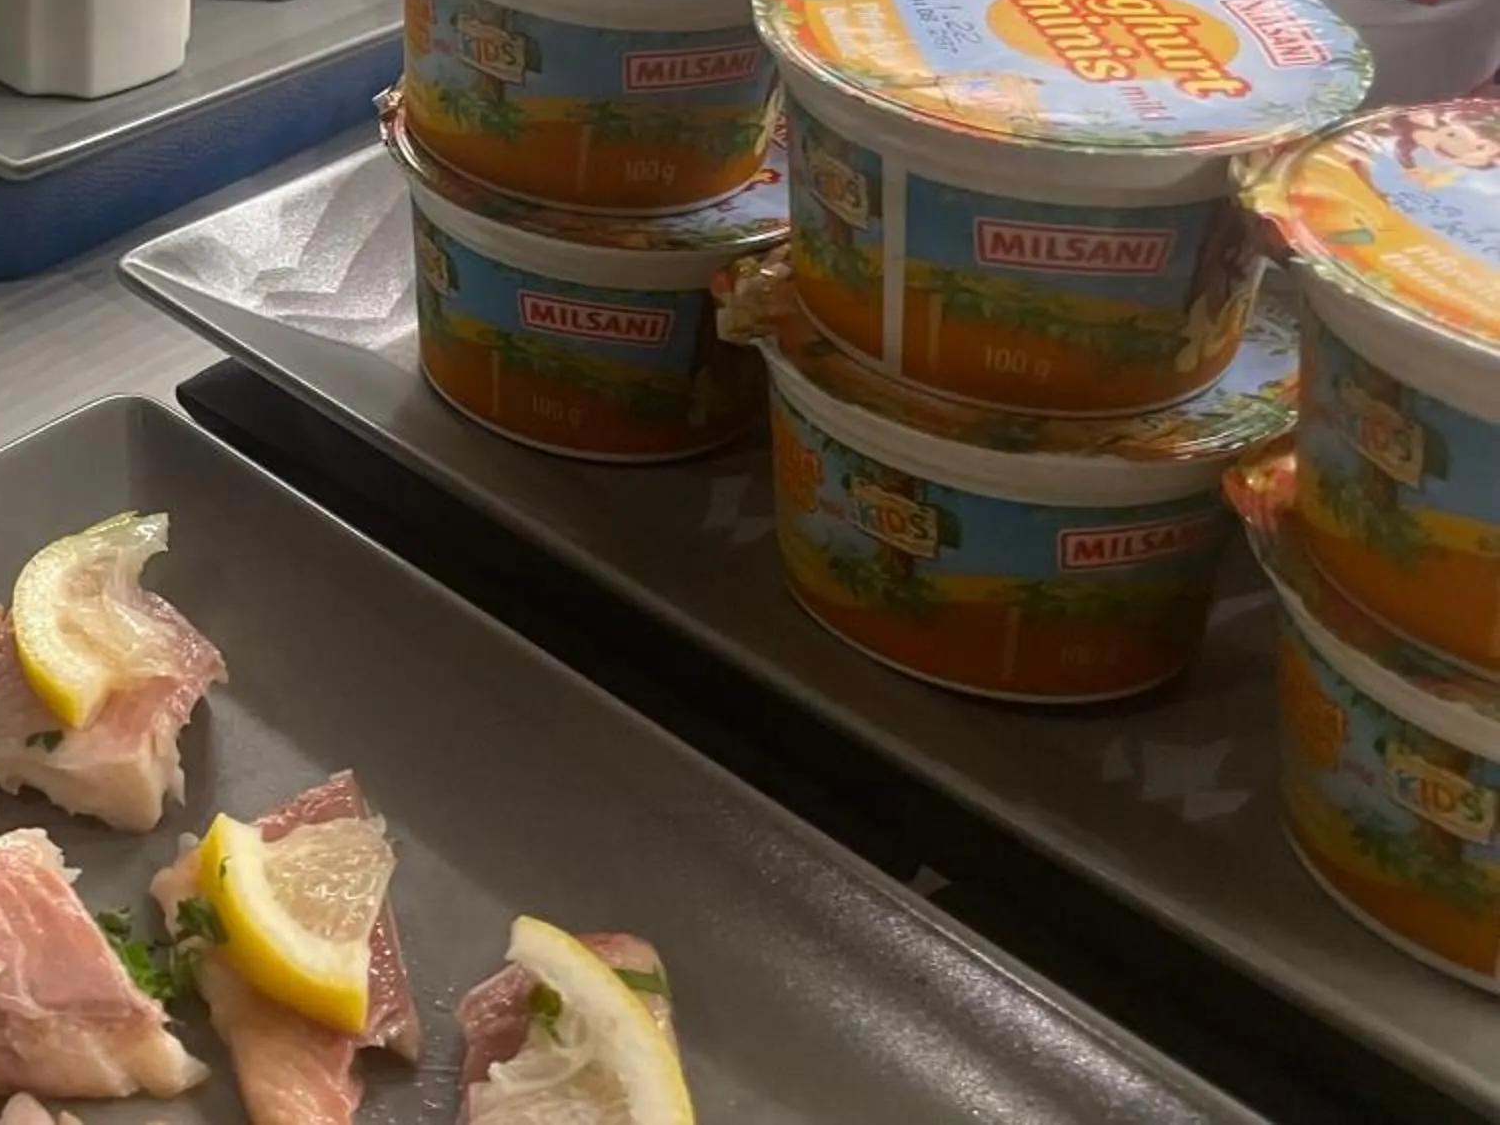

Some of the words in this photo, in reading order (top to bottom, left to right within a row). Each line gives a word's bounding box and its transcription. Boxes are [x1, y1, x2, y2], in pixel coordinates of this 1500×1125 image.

[636, 48, 757, 84] MILSANI
[986, 228, 1158, 267] MILSANI
[529, 301, 660, 339] MILSANI
[983, 344, 1028, 374] 100
[1073, 522, 1206, 563] MILSA
